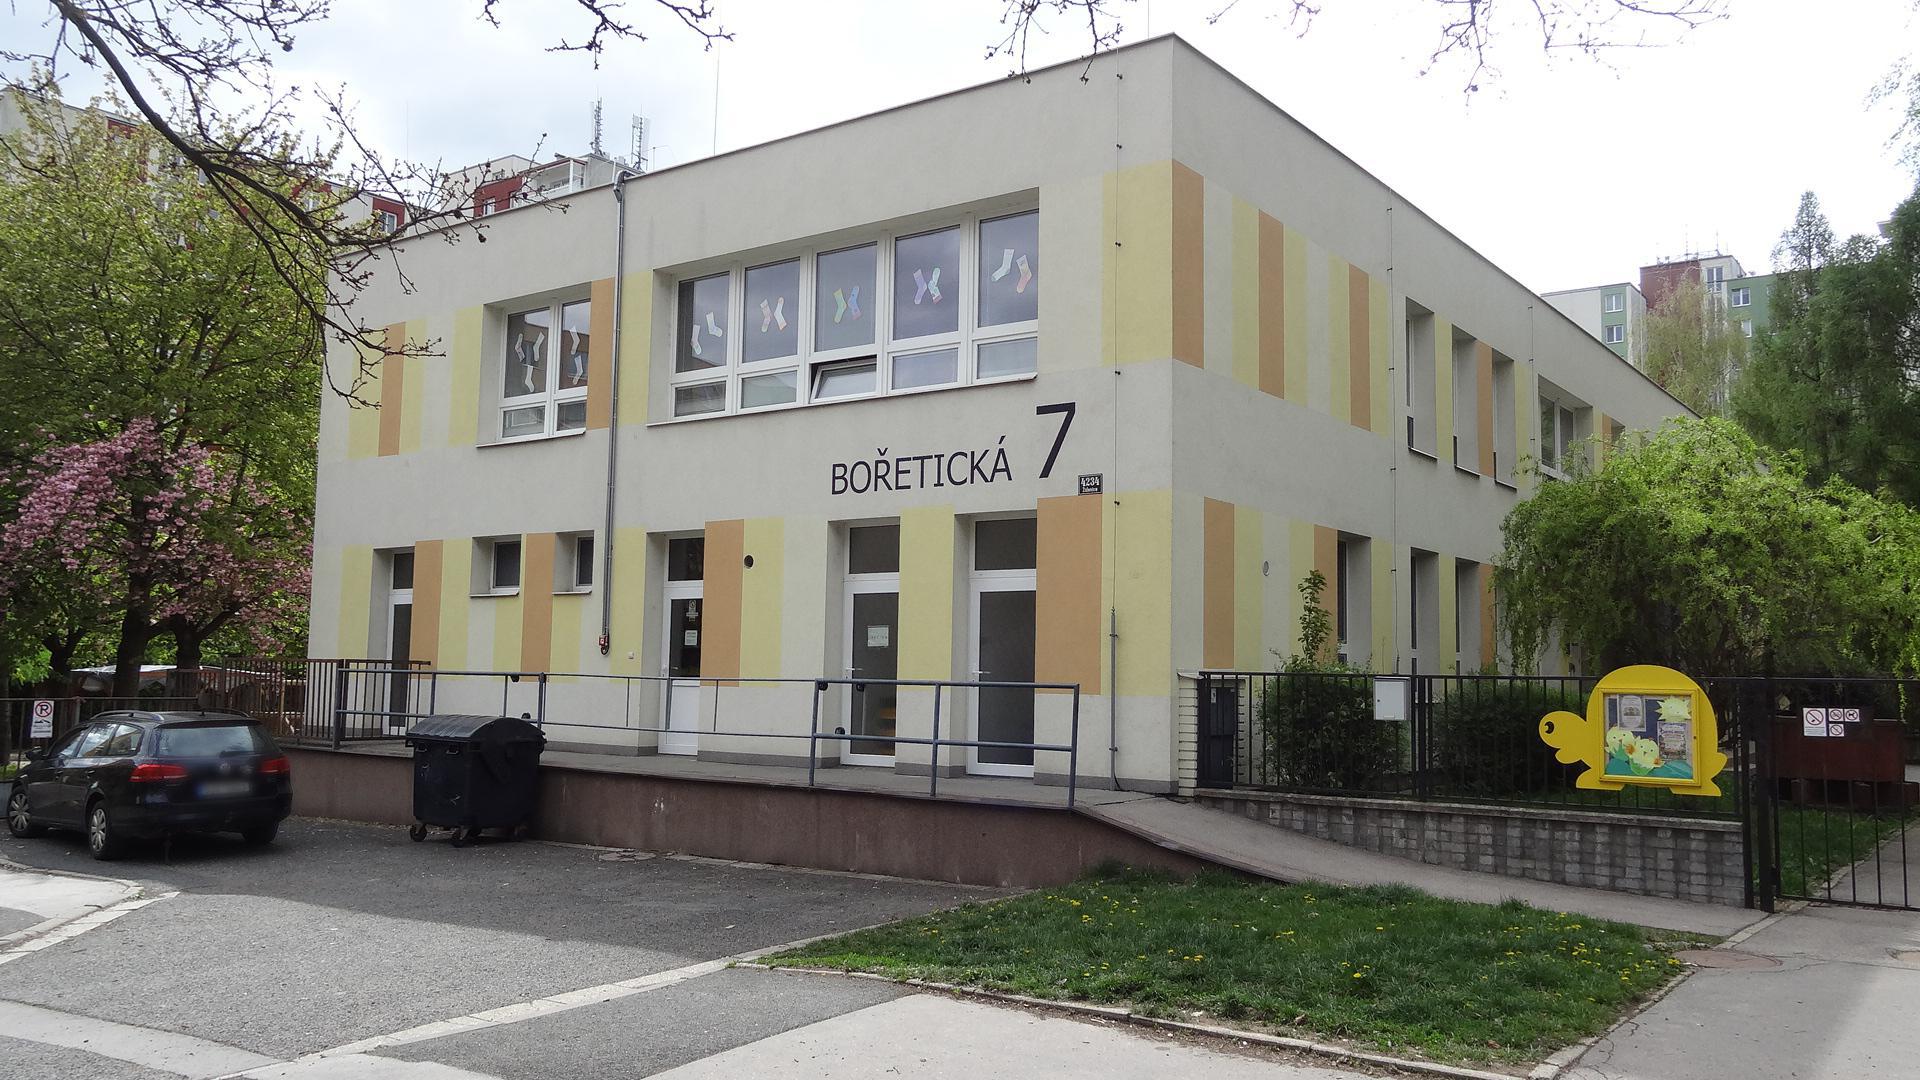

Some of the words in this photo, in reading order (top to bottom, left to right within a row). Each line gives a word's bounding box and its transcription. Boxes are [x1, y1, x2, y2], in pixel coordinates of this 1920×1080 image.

[831, 435, 1012, 495] BOŘETICKÁ
[1035, 401, 1076, 479] 7
[1080, 476, 1100, 487] 4234
